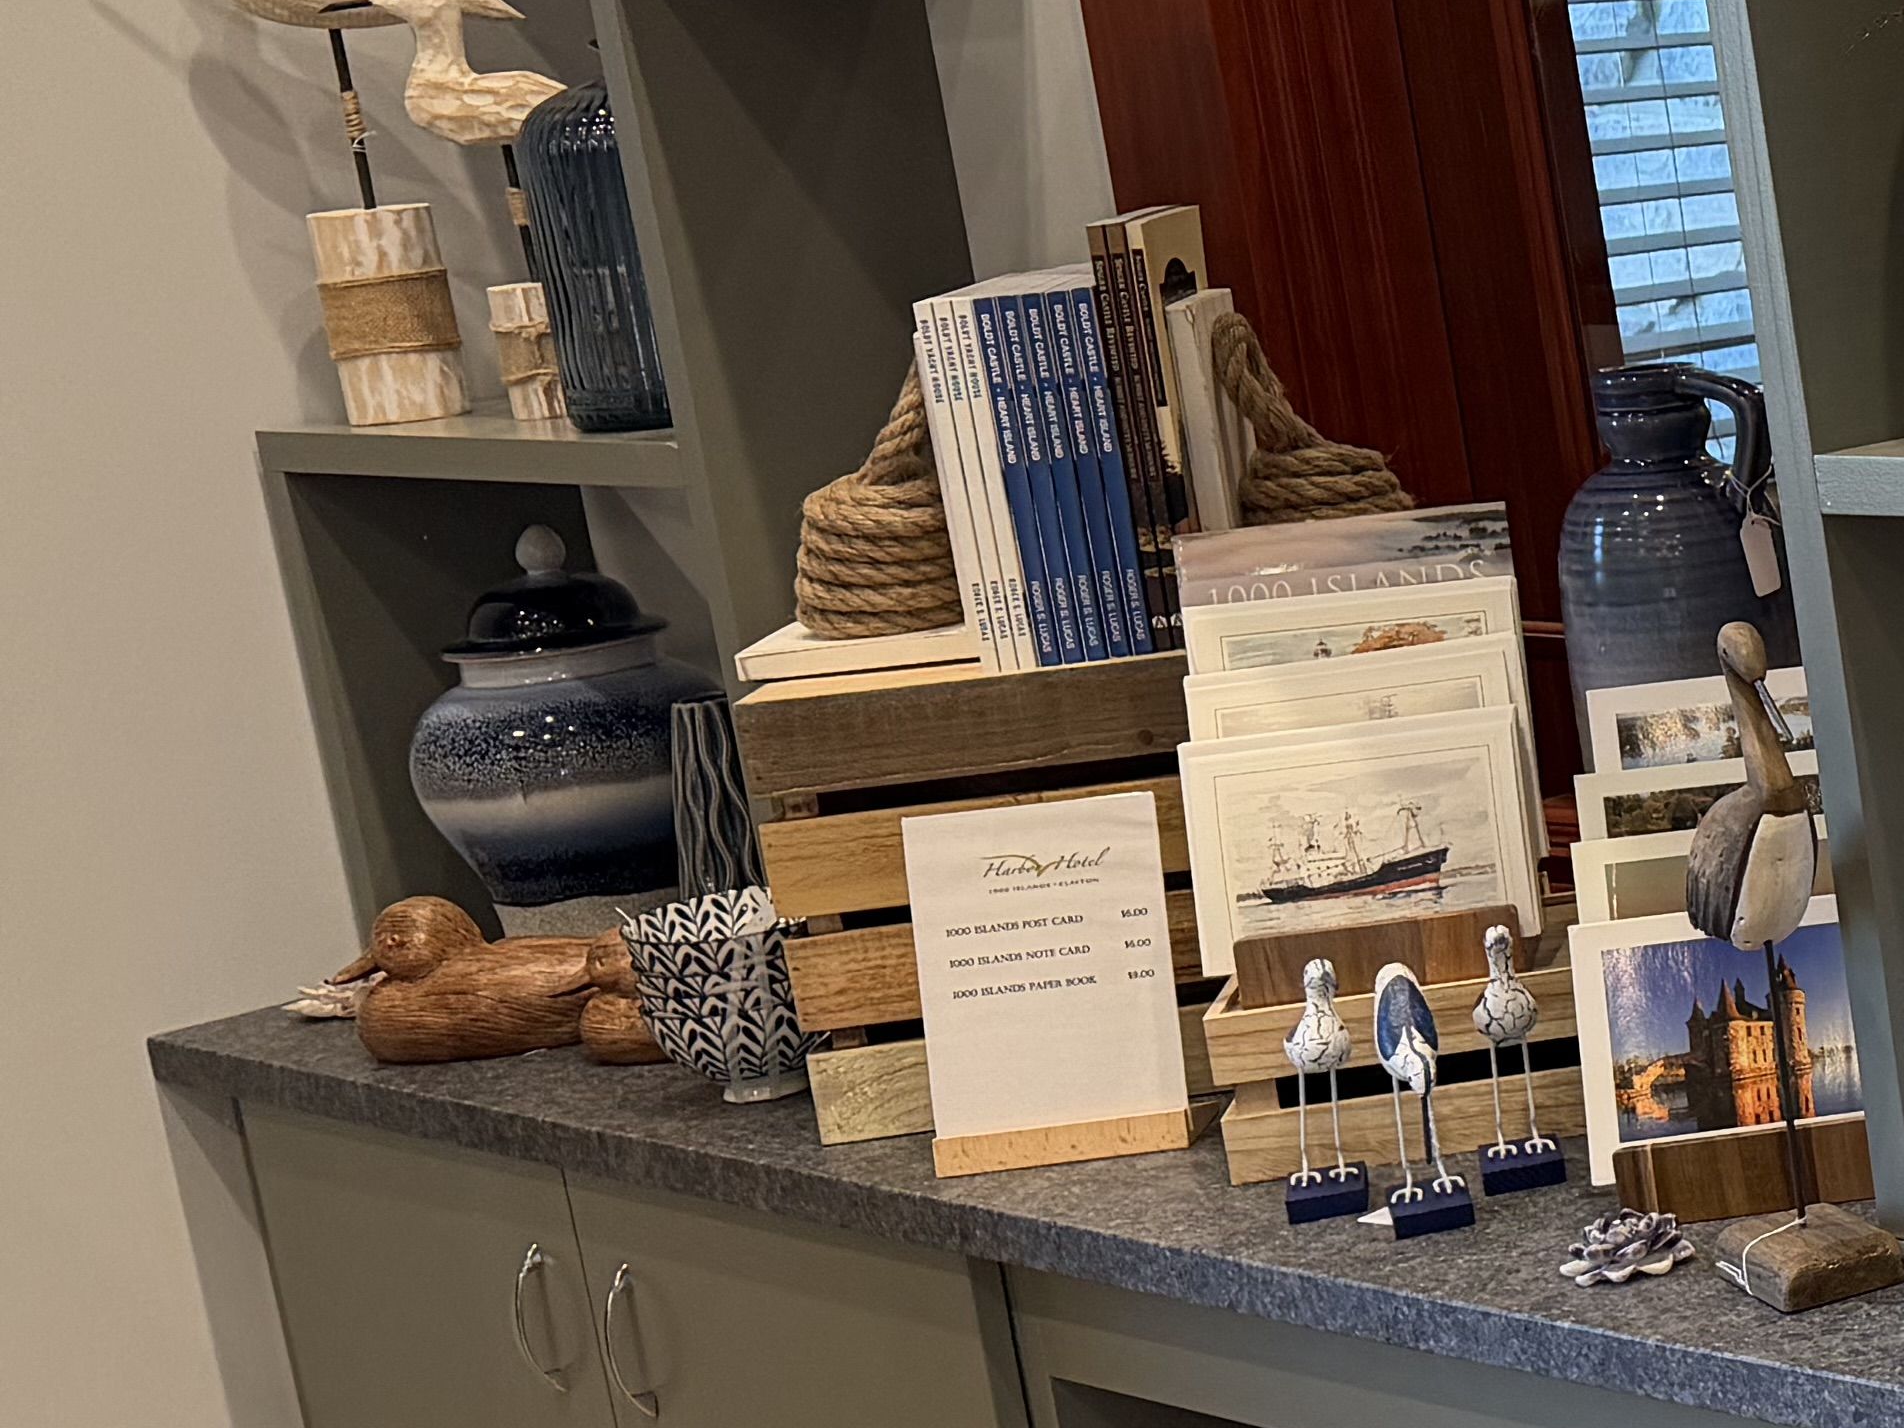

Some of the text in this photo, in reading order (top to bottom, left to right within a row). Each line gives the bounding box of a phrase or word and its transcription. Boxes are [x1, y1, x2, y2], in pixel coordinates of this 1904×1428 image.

[981, 313, 994, 345] BOLDT
[1054, 303, 1066, 336] BOLDT
[1079, 302, 1091, 334] BOLDT
[987, 347, 1000, 384] CASTLE
[1060, 337, 1073, 374] CASTLE
[1085, 335, 1098, 372] CASTLE
[1006, 310, 1018, 341] BOLDT
[1012, 343, 1025, 381] CASTLE
[1020, 393, 1033, 424] HEART
[1027, 426, 1040, 461] ISLAND
[1029, 307, 1041, 340] BOLDT
[1035, 341, 1048, 378] CASTLE
[1043, 390, 1056, 422] HEART
[1050, 423, 1063, 458] ISLAND
[996, 396, 1008, 427] HEART
[1069, 386, 1081, 417] HEART
[1093, 384, 1106, 417] HEART
[1003, 429, 1015, 464] ISLAND
[1074, 419, 1087, 454] ISLAND
[1099, 418, 1112, 453] ISLAND
[1207, 558, 1487, 605] 1000 ISLANDS
[1030, 580, 1043, 612] ROGER
[1039, 622, 1051, 653] LUCAS
[1054, 577, 1066, 608] ROGER
[1062, 619, 1074, 649] LUCAS
[1077, 574, 1090, 606] ROGER
[1085, 617, 1097, 646] LUCAS
[1101, 570, 1113, 601] ROGER
[1109, 612, 1121, 642] LUCAS
[1125, 568, 1138, 600] ROGER
[1133, 610, 1145, 640] LUCAS
[1054, 846, 1111, 870] Hotel
[945, 927, 972, 938] 1000
[974, 921, 1019, 935] ISLANDS
[1022, 918, 1049, 930] POST
[1051, 915, 1084, 927] CARD
[949, 957, 975, 969] 1000
[977, 952, 1023, 966] ISLANDS
[1026, 949, 1055, 960] NOTE
[1058, 945, 1091, 956] CARD
[952, 988, 979, 1000] 1000
[981, 982, 1027, 997] ISLANDS
[1029, 979, 1063, 992] PAPER
[1065, 975, 1097, 987] BOOK
